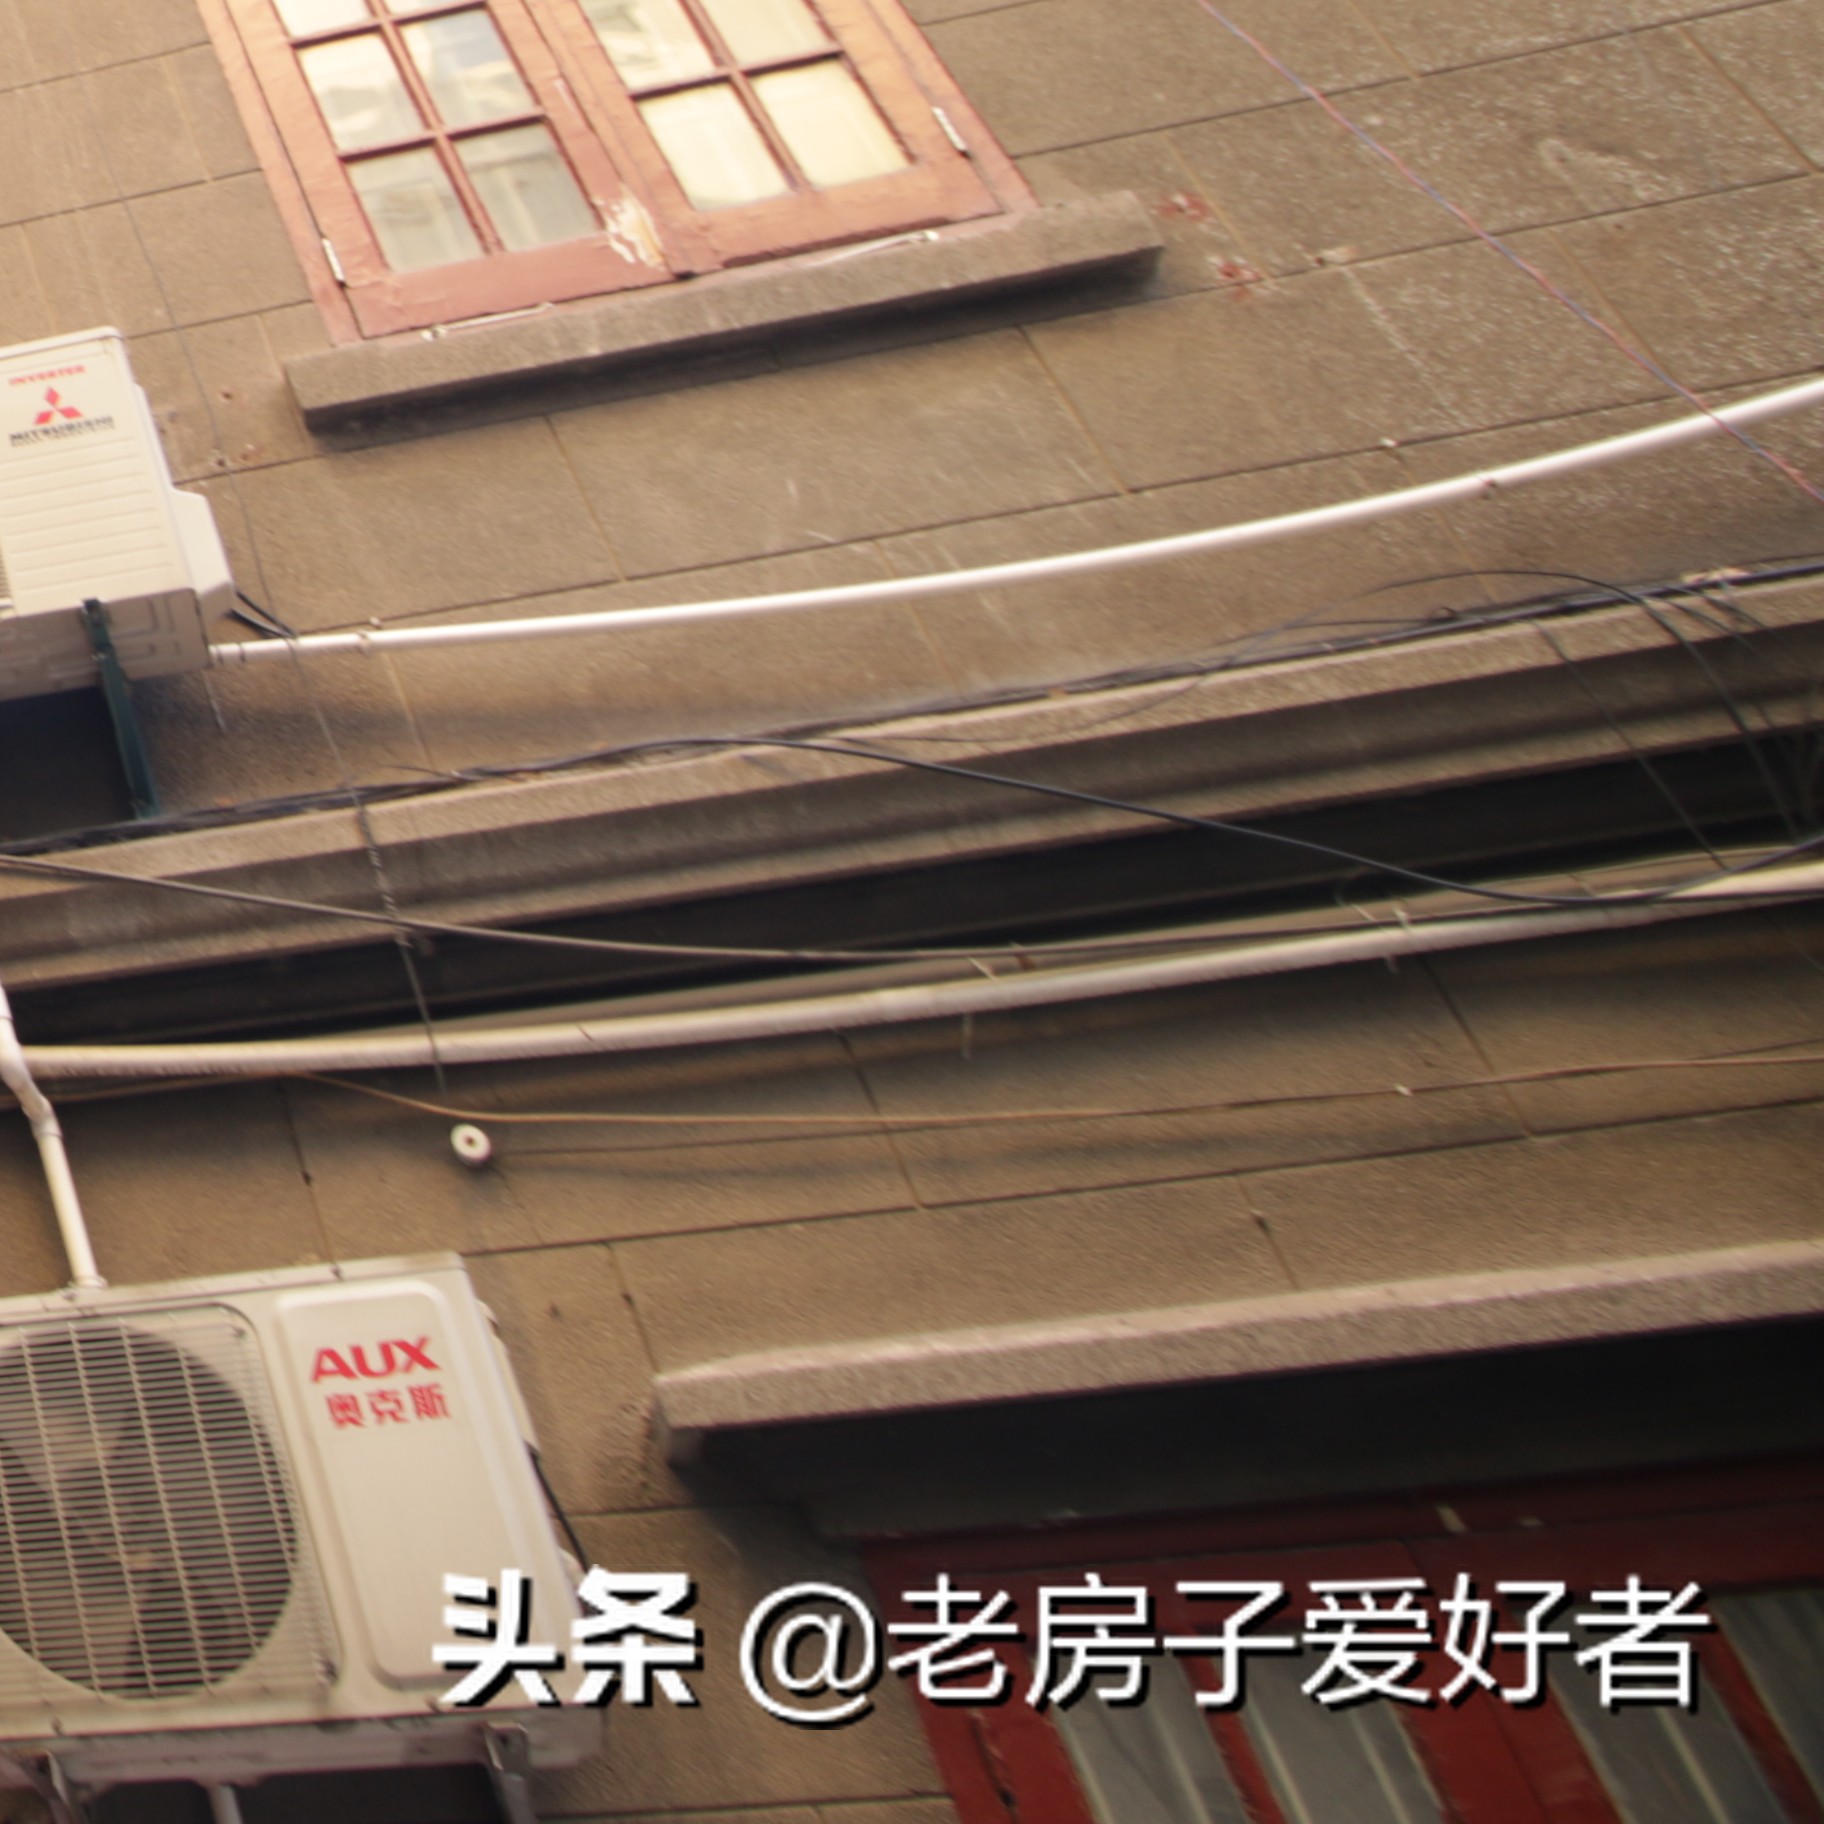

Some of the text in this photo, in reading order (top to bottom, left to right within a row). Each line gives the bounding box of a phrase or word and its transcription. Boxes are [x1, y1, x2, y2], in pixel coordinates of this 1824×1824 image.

[9, 364, 87, 386] INVERTER
[310, 1336, 440, 1383] AUX
[325, 1383, 449, 1429] 奥克斯
